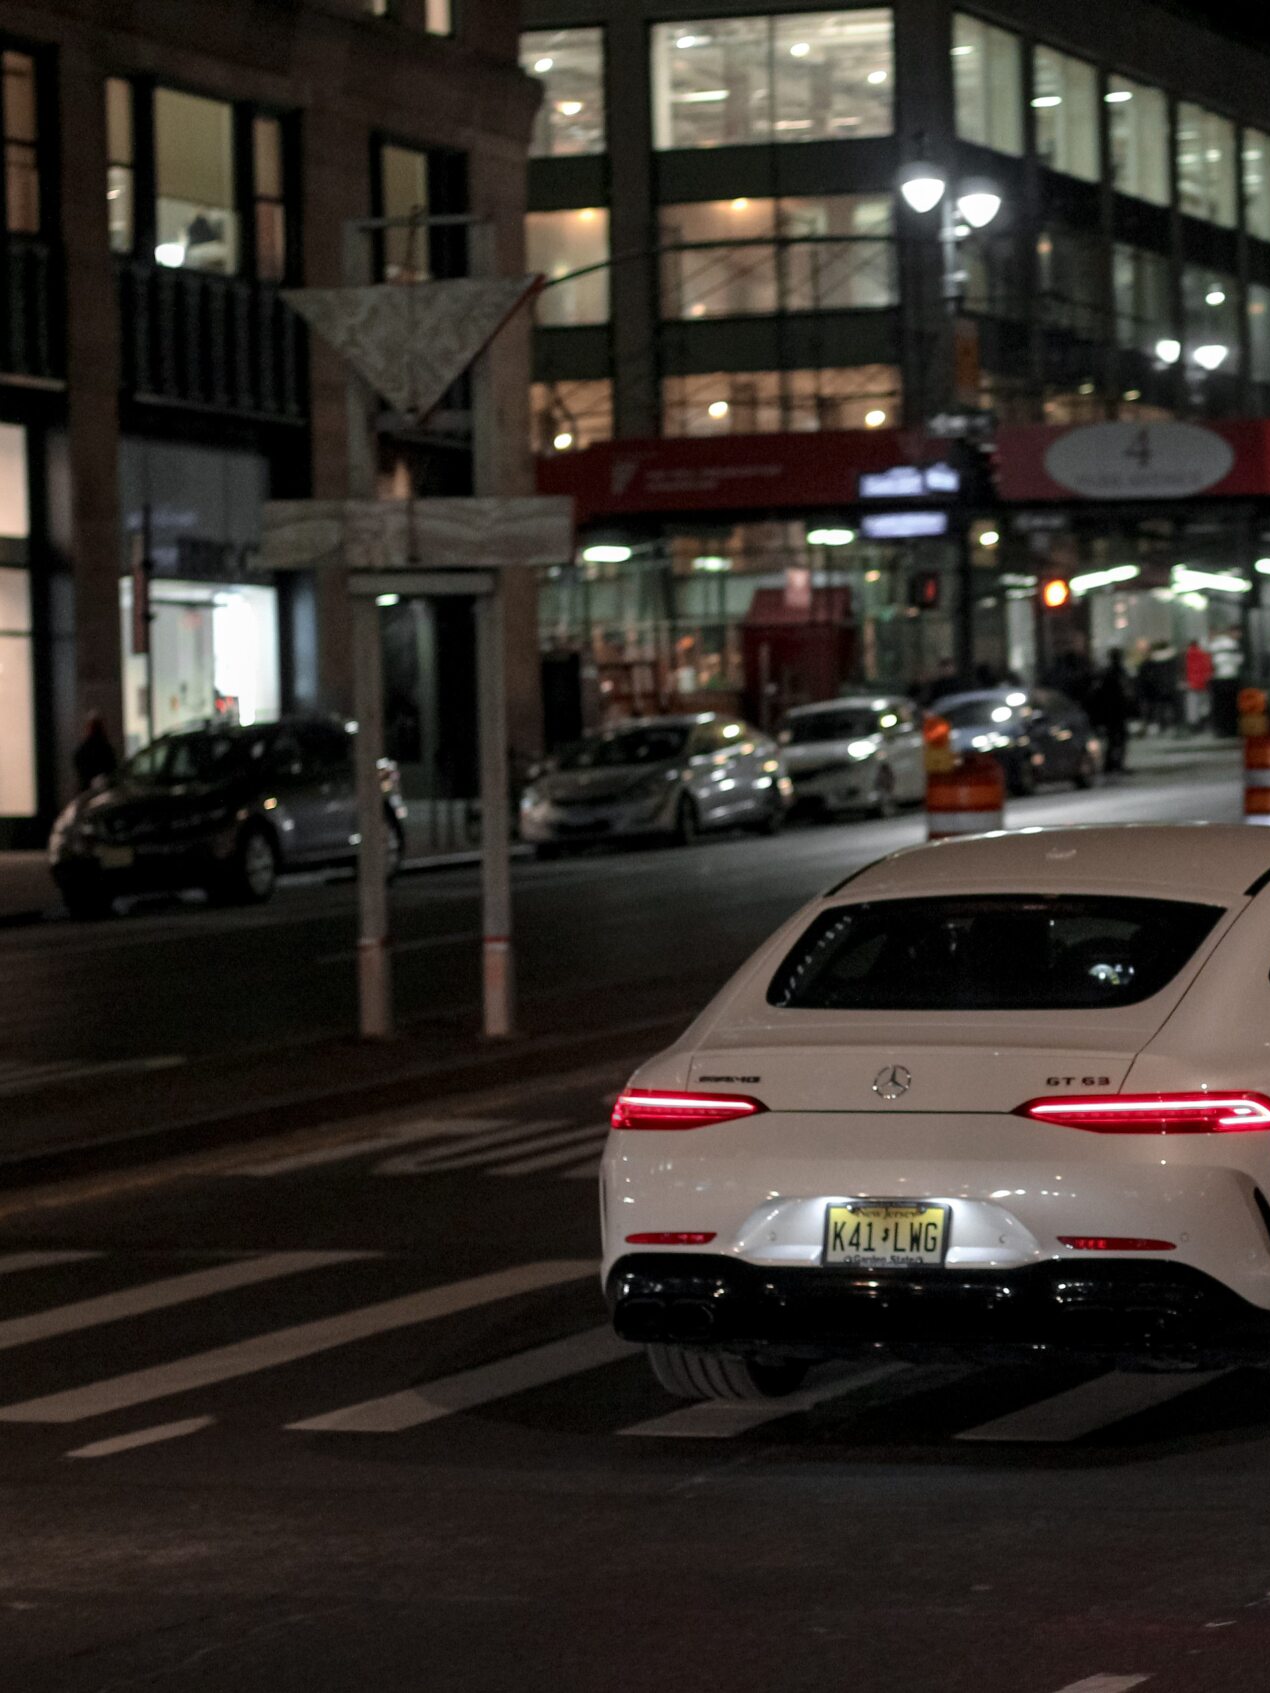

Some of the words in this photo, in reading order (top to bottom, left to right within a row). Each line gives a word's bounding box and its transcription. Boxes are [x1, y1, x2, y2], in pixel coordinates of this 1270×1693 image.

[1122, 429, 1153, 467] 4
[1045, 1076, 1076, 1087] GT
[1081, 1076, 1110, 1087] 63
[832, 1221, 875, 1252] K41
[893, 1221, 938, 1252] LWG
